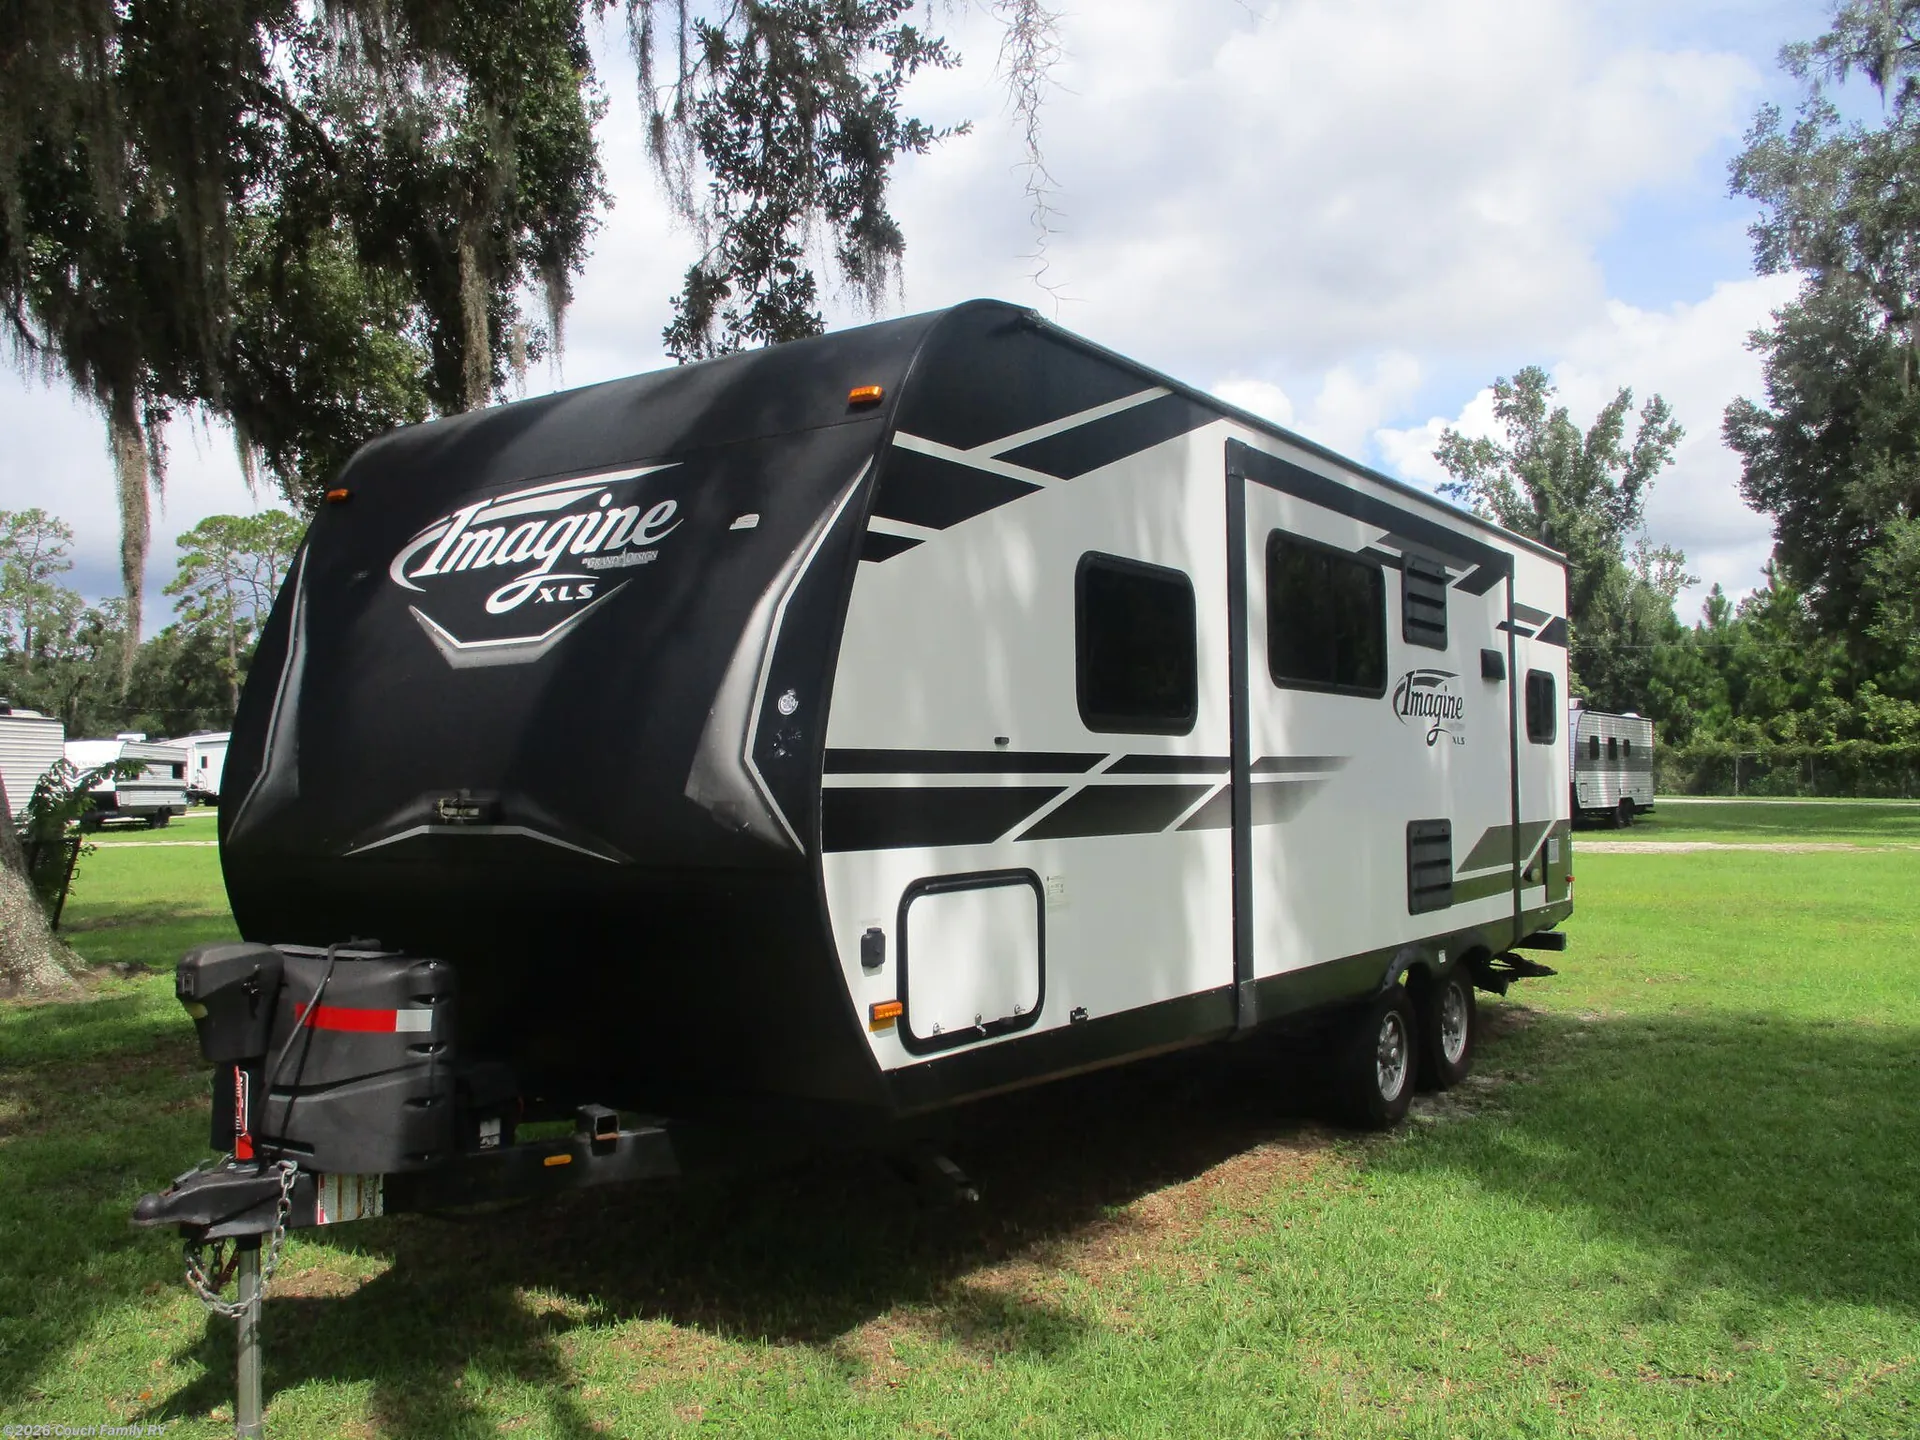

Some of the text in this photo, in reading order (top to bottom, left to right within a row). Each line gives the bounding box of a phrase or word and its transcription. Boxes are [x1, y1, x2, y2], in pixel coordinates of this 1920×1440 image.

[409, 493, 684, 614] Imagine
[535, 583, 596, 604] XLS
[1401, 670, 1464, 747] Imagine
[1452, 736, 1465, 745] XLS
